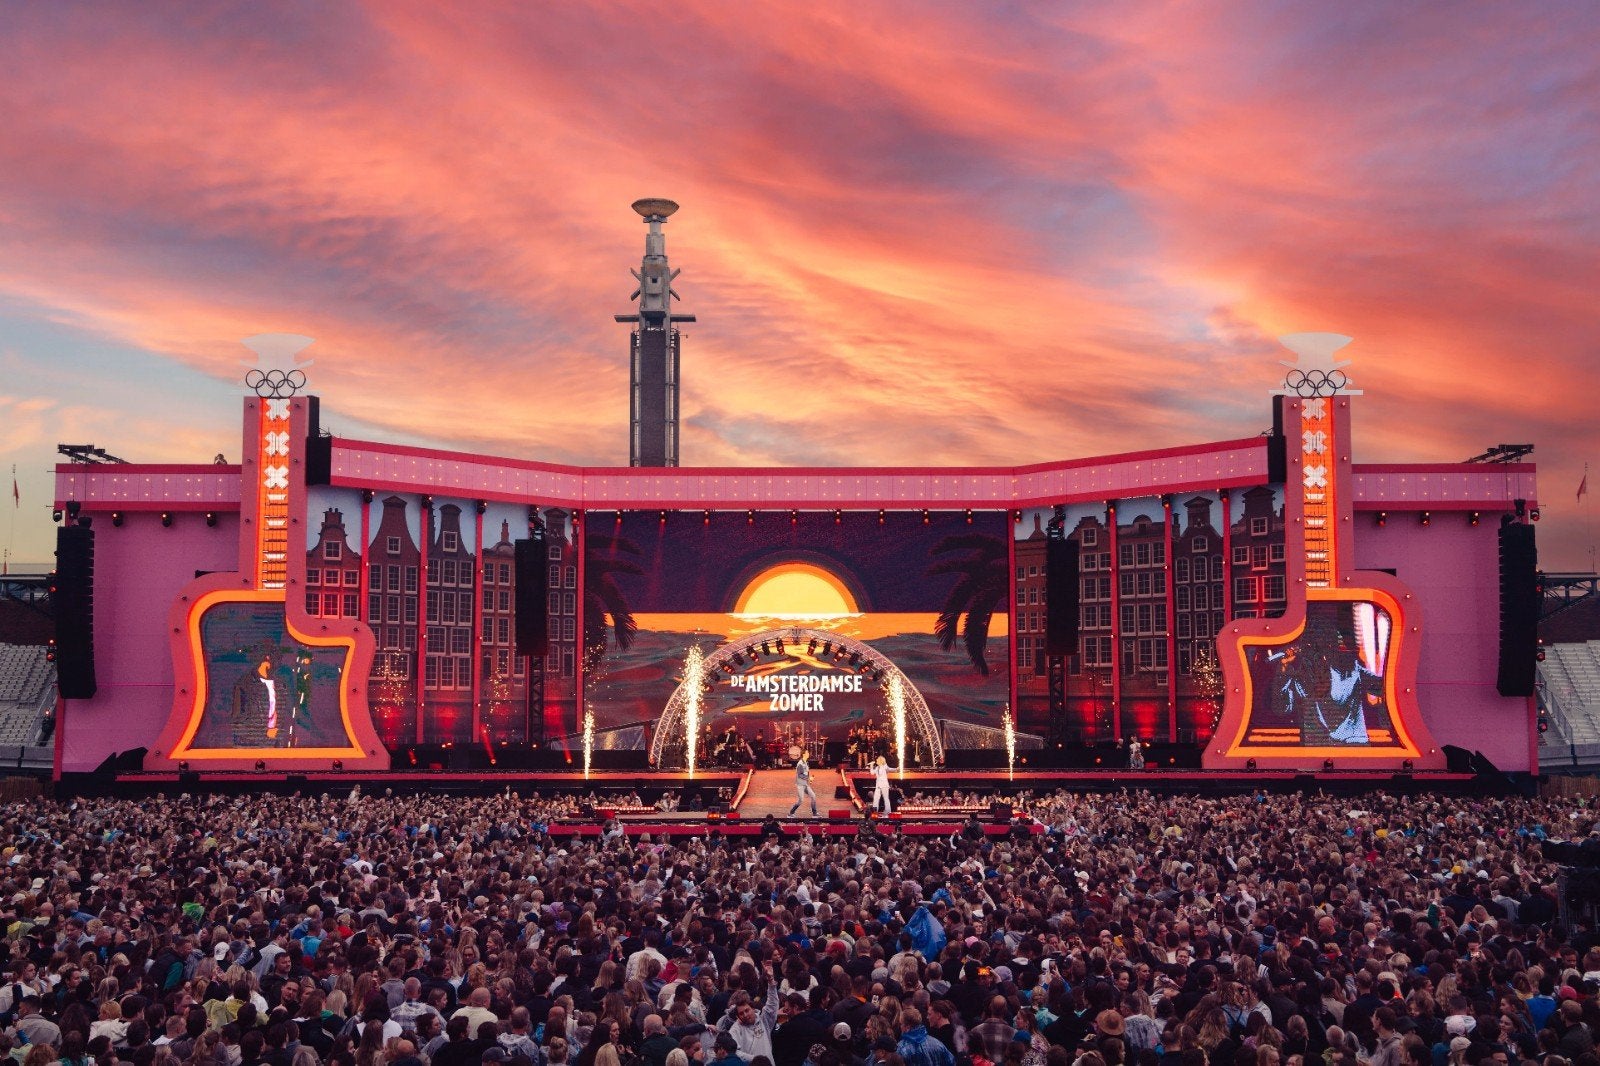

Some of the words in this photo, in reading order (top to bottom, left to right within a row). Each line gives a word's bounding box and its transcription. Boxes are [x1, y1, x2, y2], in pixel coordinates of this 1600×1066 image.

[730, 675, 745, 688] DE
[745, 675, 863, 693] AMSTERDAMSE
[769, 693, 825, 712] ZOMER
